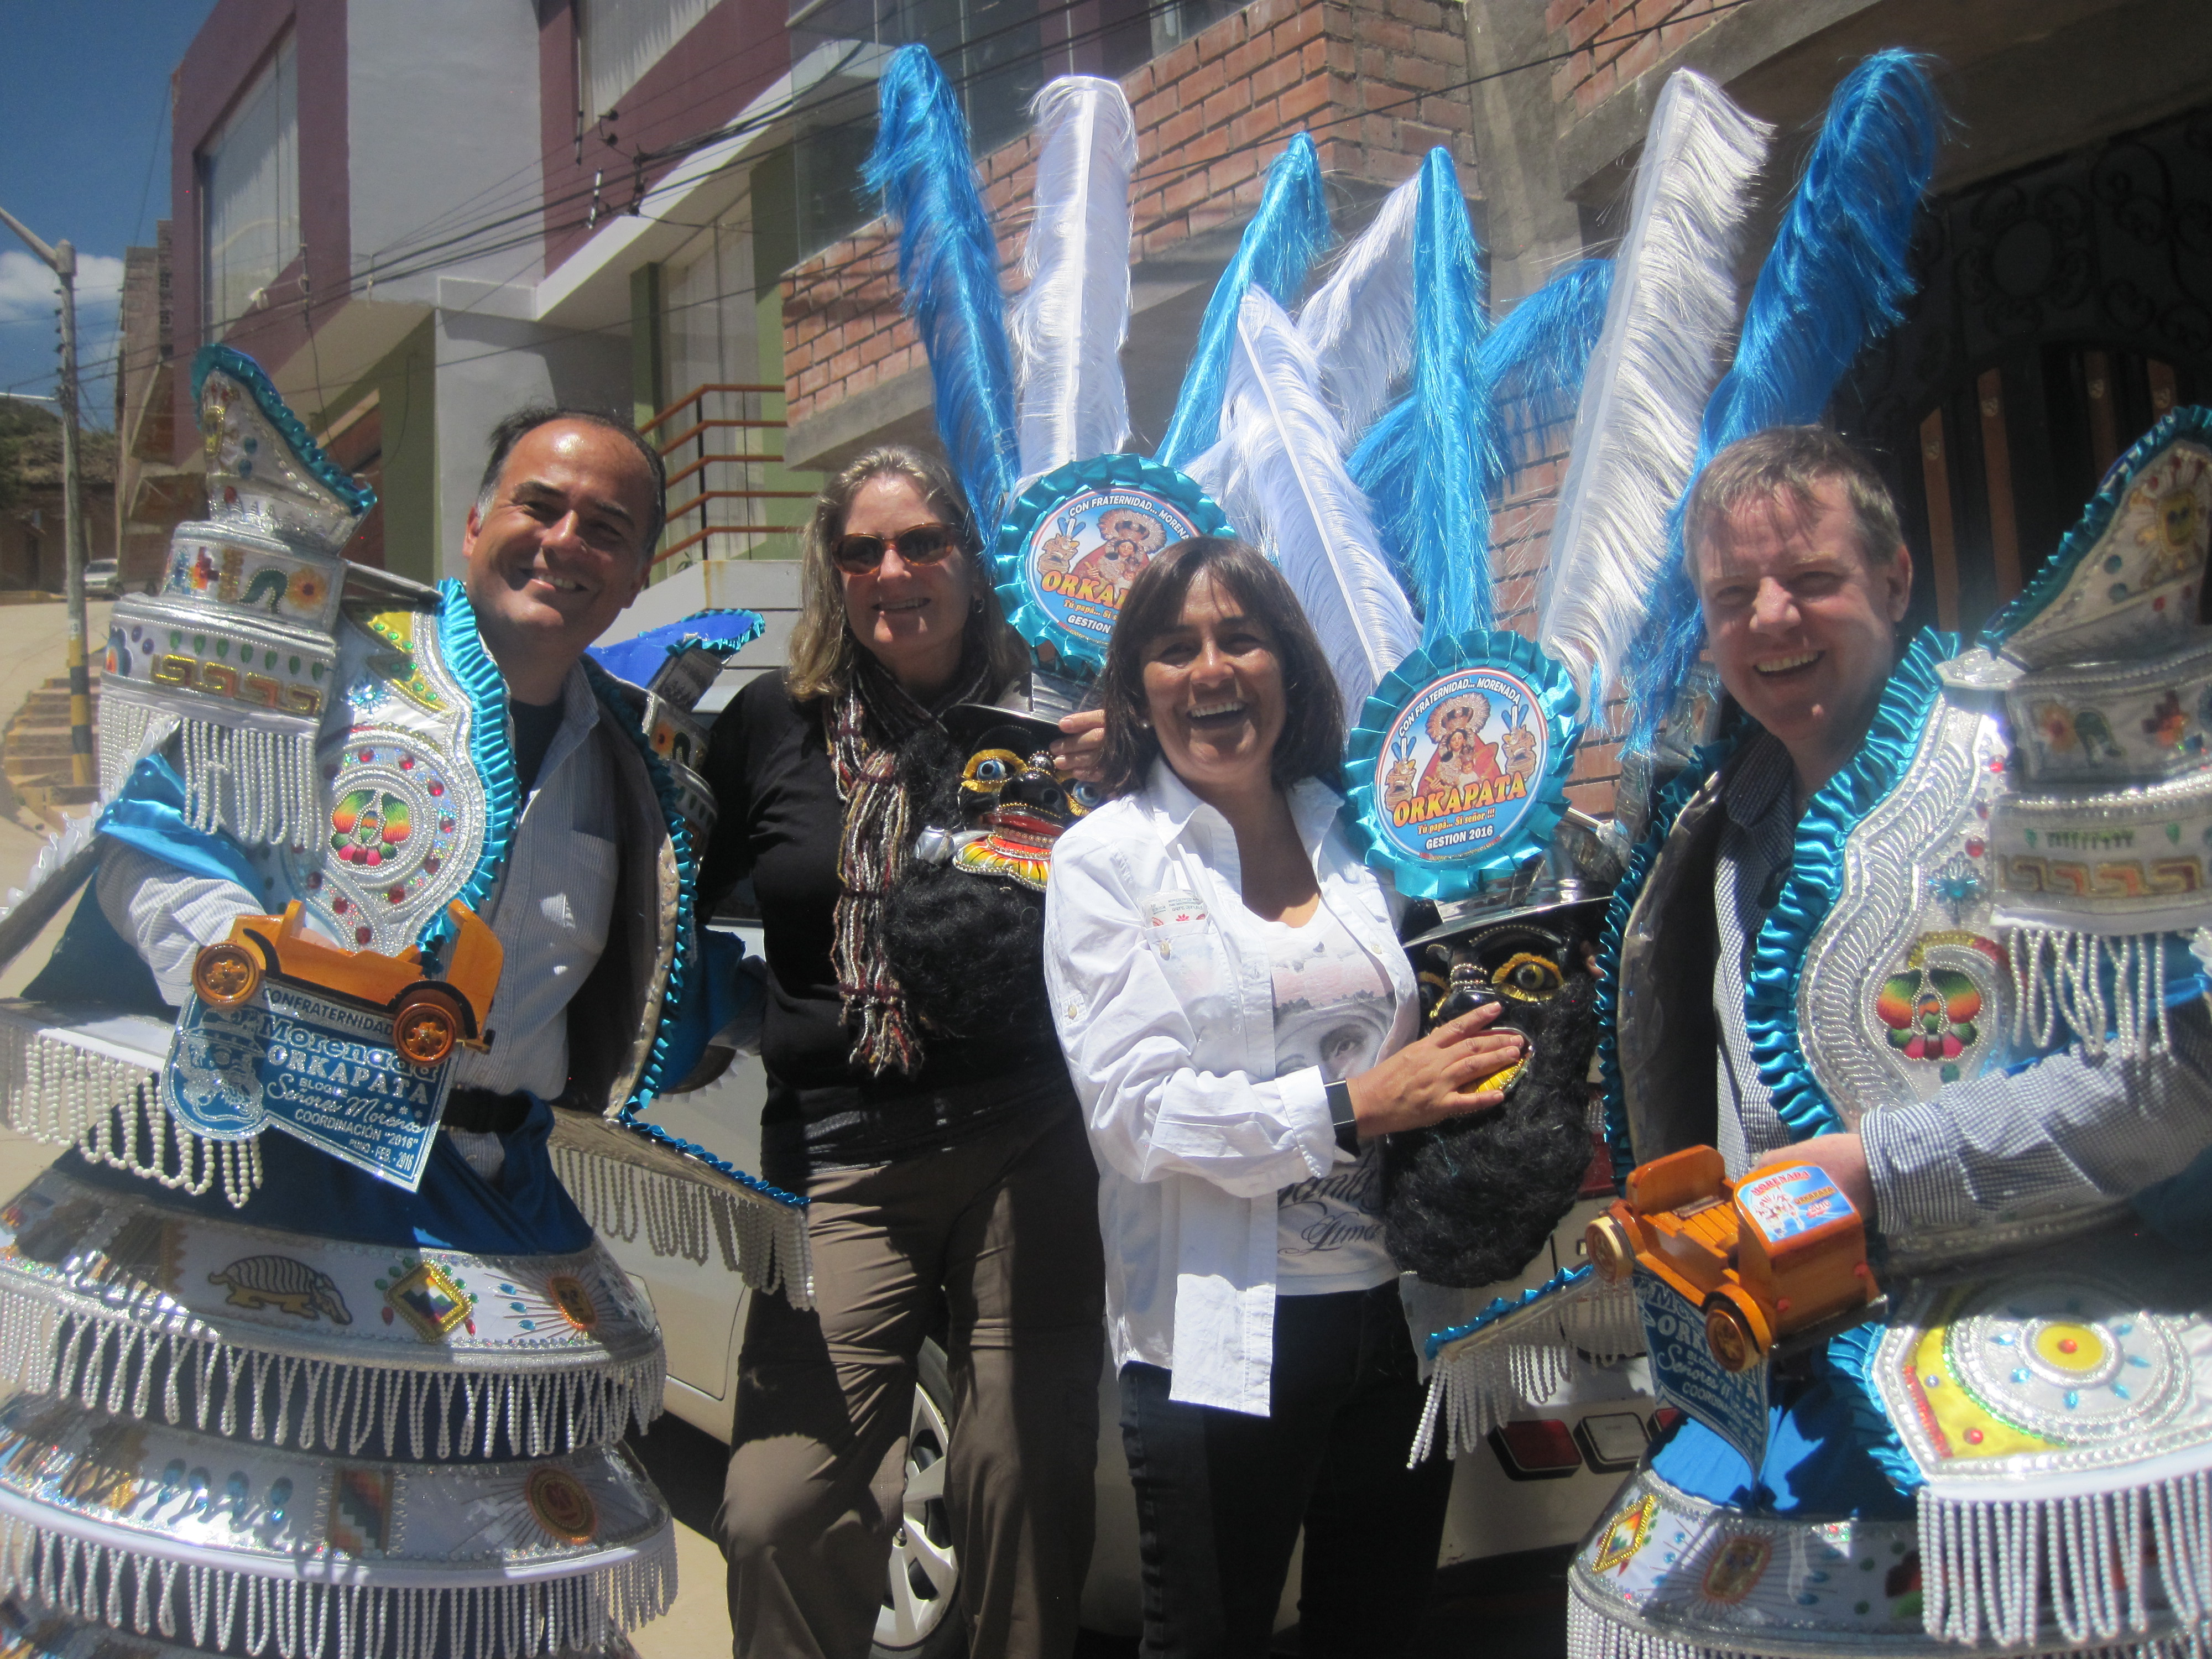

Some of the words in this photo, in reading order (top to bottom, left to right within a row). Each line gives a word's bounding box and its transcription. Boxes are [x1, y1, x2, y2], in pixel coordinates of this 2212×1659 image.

[1070, 501, 1089, 517] CON
[1067, 614, 1112, 634] GESTION
[1399, 714, 1415, 737] CON
[1477, 677, 1521, 705] MORENADA
[1393, 771, 1527, 827] ORKAPATA
[1426, 831, 1466, 850] GESTION
[1469, 825, 1493, 840] 2016
[268, 1045, 429, 1104] ORKAPATA
[299, 1078, 348, 1098] BLOQUE
[295, 1109, 382, 1141] COORDINACIÓN
[345, 1096, 426, 1133] Morenos
[349, 1139, 371, 1154] PUNO
[395, 1152, 414, 1171] 2016
[1751, 1170, 1811, 1196] MORENADA
